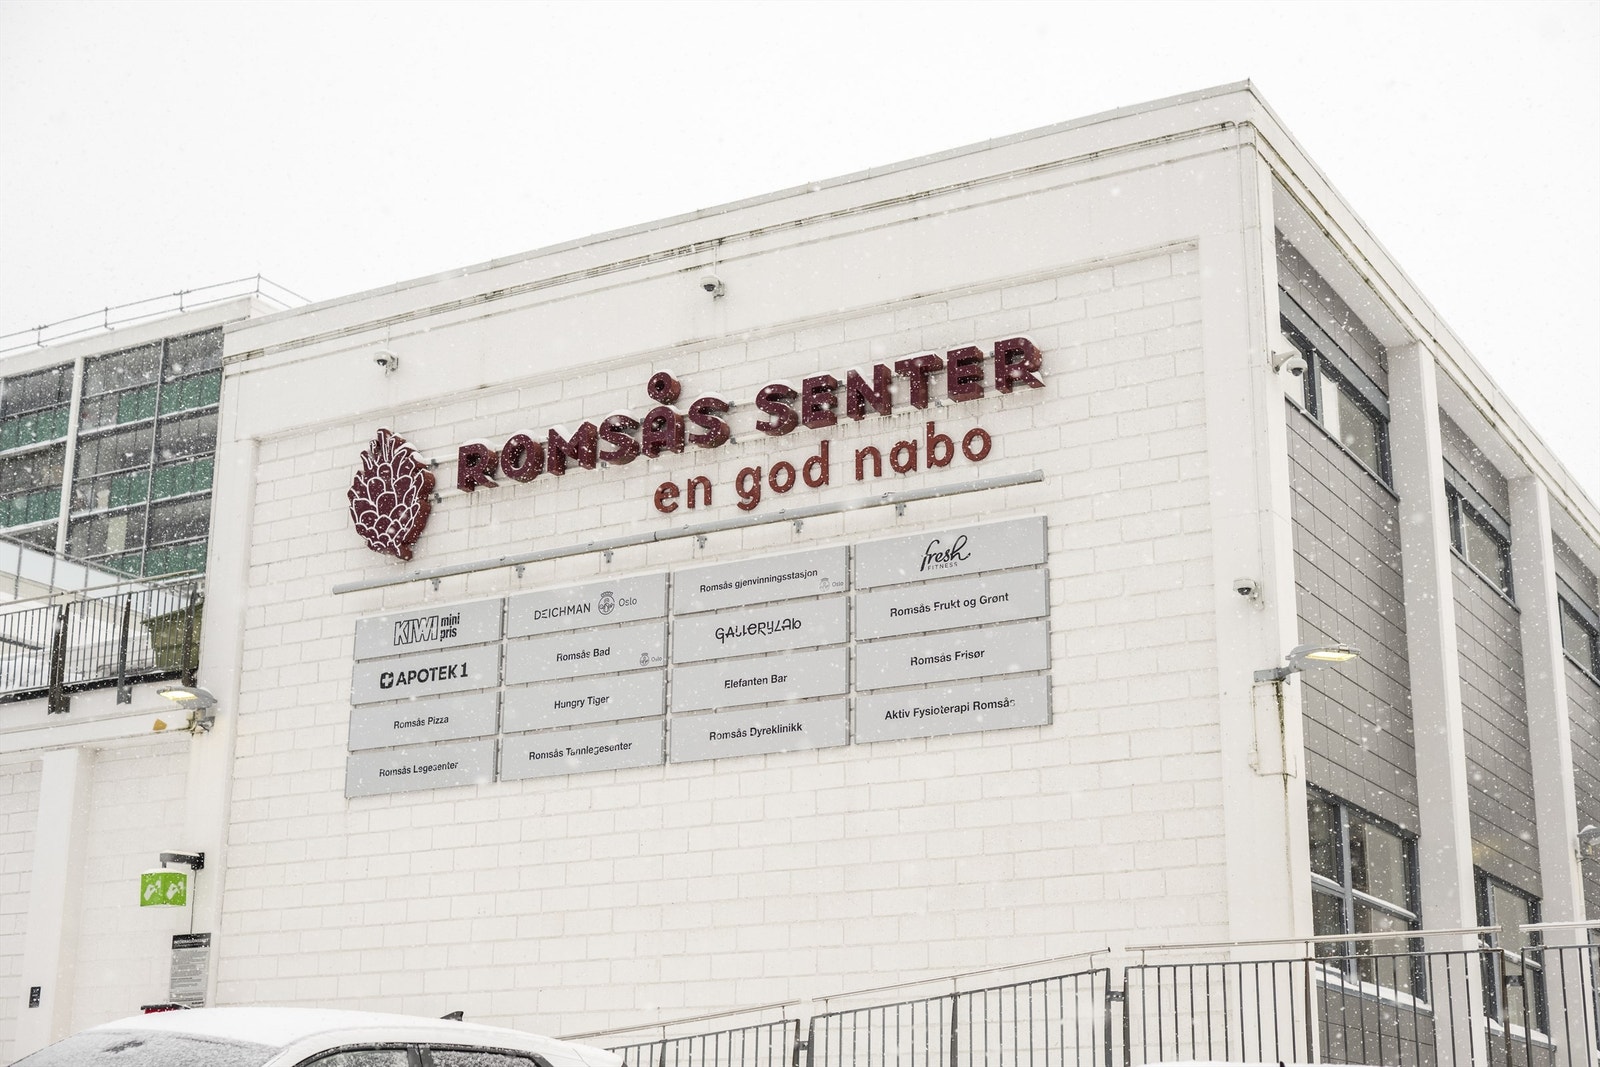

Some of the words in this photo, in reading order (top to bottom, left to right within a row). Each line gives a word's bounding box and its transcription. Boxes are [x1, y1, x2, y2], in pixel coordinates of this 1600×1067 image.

[457, 371, 730, 492] ROMSÅS
[755, 336, 1046, 436] SENTER
[653, 471, 712, 513] en
[735, 440, 829, 511] god
[854, 422, 993, 481] nabo
[919, 534, 971, 572] fresh
[927, 561, 958, 571] FITNESS
[699, 581, 733, 593] Romsås
[734, 569, 818, 589] gjenvinningsstasjon
[534, 602, 591, 620] DEICHMAN
[618, 597, 638, 607] Oslo
[890, 603, 931, 617] Romsås
[933, 599, 961, 611] Frukt
[963, 598, 977, 608] og
[979, 592, 1009, 605] Grønt
[440, 612, 461, 627] mini
[393, 615, 440, 646] KIWI
[440, 626, 458, 642] pris
[556, 649, 592, 662] Romsås
[593, 647, 611, 657] Bad
[910, 653, 952, 666] Romsås
[954, 649, 985, 661] Frisør
[395, 664, 458, 686] APOTEK
[460, 662, 469, 678] 1
[724, 677, 768, 689] Elefanten
[771, 674, 788, 683] Bar
[554, 698, 586, 710] Hungry
[587, 695, 610, 706] Tiger
[884, 708, 911, 720] Aktiv
[913, 701, 971, 718] Fysioterapi
[972, 696, 1016, 711] Romsås
[393, 717, 426, 730] Romsås
[427, 716, 450, 726] Pizza
[710, 728, 748, 741] Romsås
[749, 722, 803, 738] Dyreklinikk
[528, 748, 564, 761] Romsås
[566, 741, 633, 757] Tannlegesenter
[379, 766, 412, 778] Romsås
